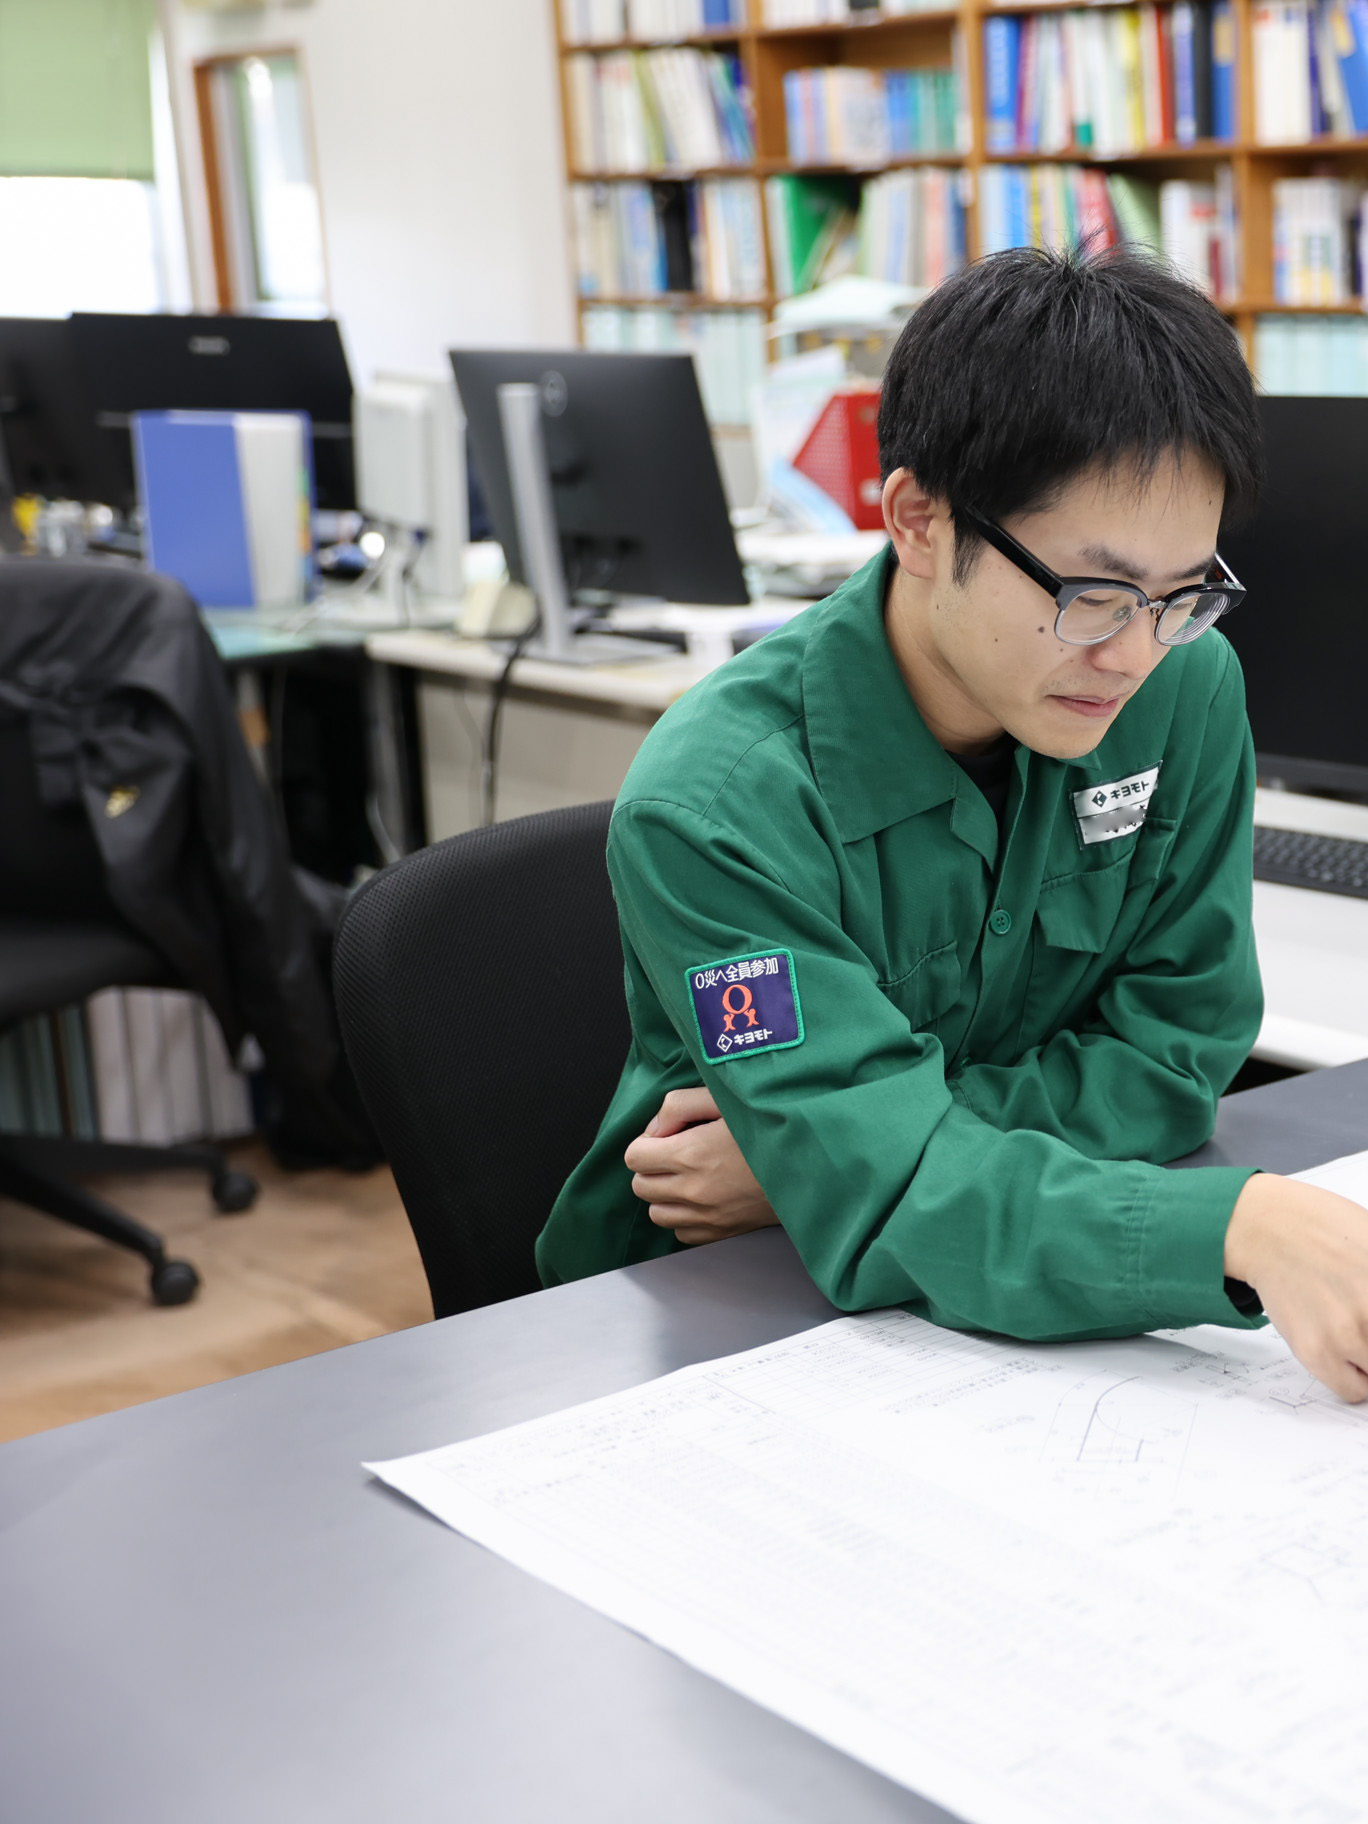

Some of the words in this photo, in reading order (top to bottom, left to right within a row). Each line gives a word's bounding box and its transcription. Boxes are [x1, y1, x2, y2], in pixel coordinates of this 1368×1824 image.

[1110, 781, 1149, 799] キヨモト
[733, 1028, 773, 1046] キヨモト
